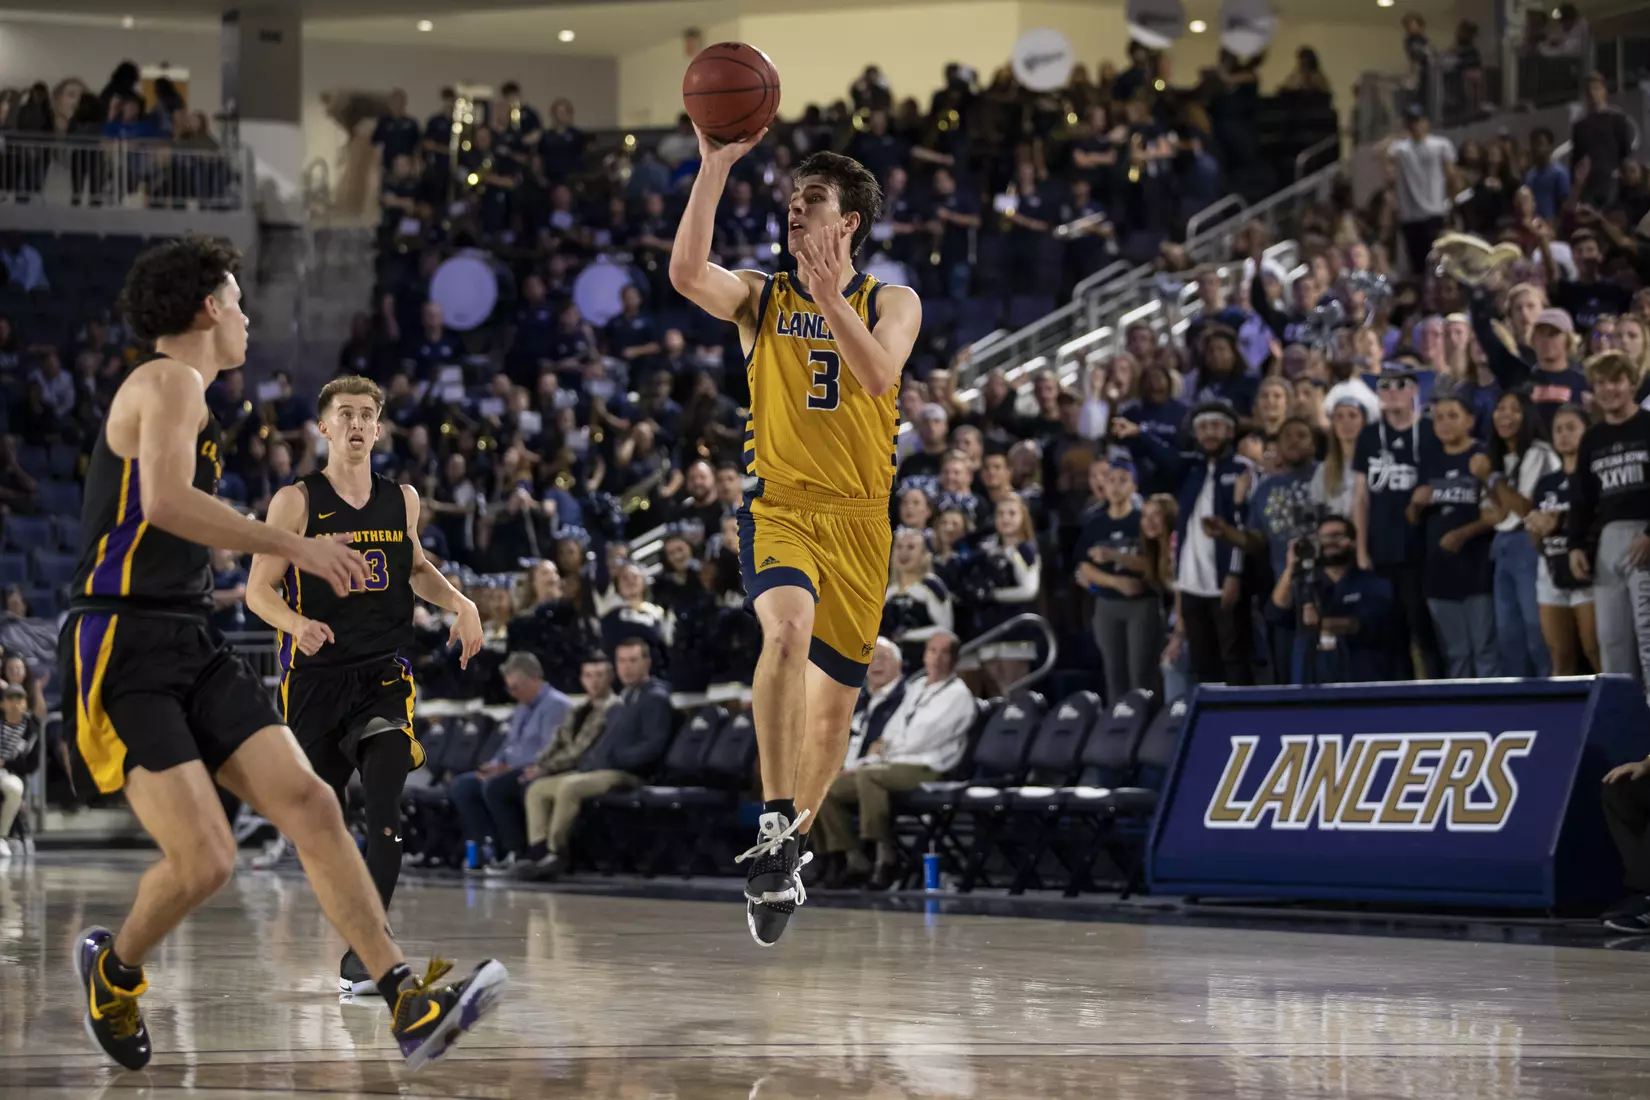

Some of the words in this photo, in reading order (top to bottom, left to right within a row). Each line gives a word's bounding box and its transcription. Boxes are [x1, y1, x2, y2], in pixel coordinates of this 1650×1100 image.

[777, 311, 835, 340] LANC
[807, 350, 841, 411] 3
[1203, 730, 1538, 832] LANCERS
